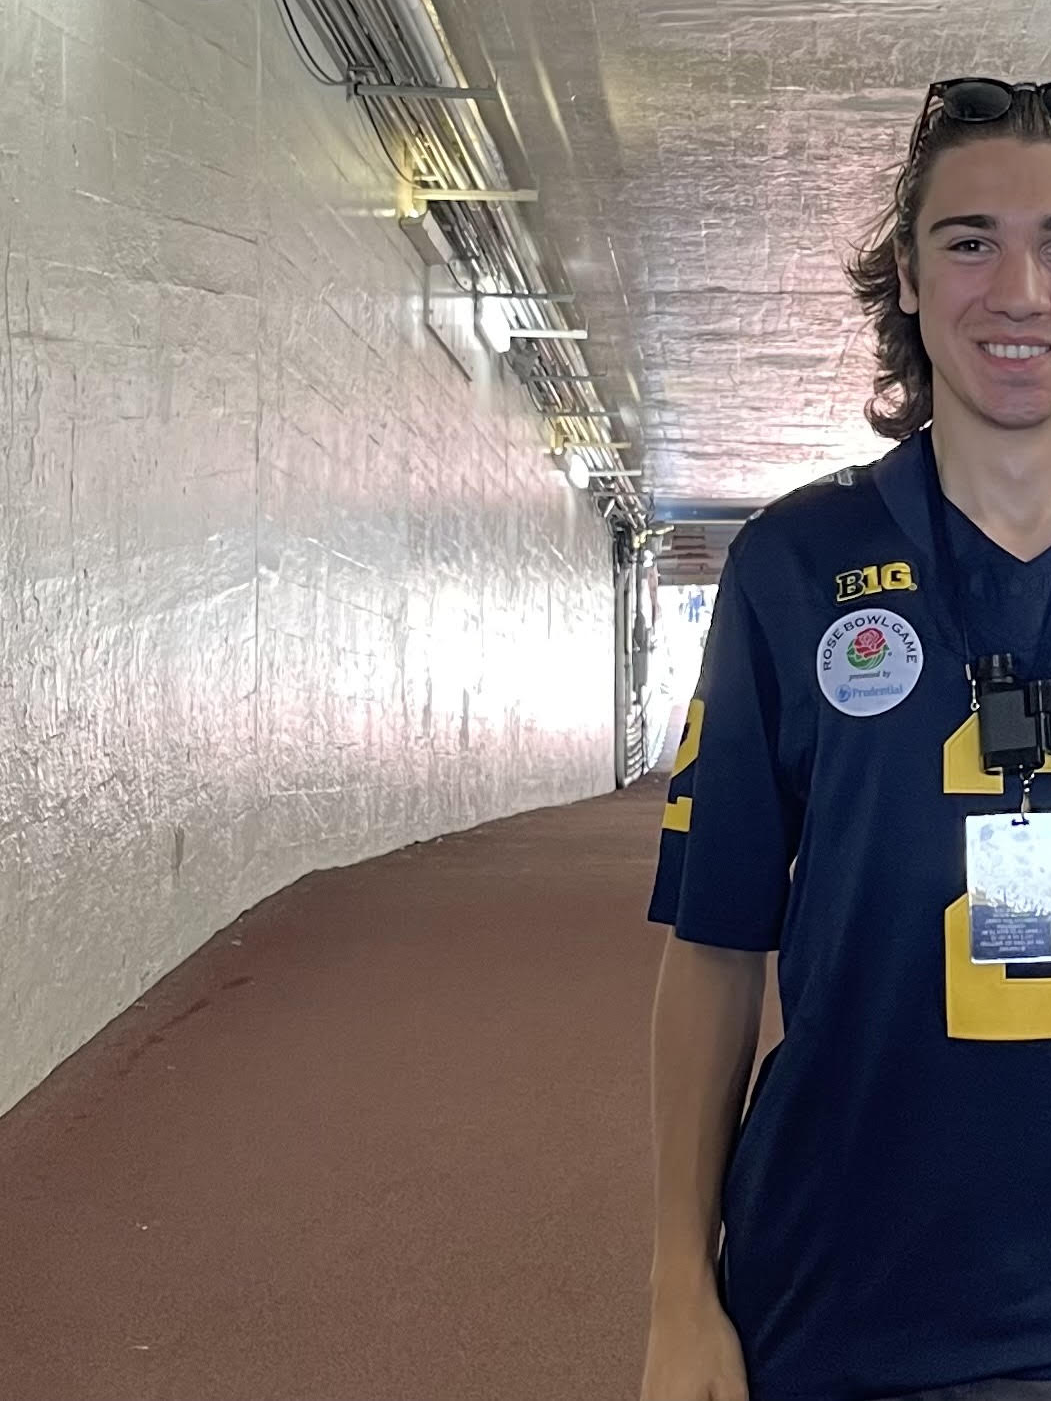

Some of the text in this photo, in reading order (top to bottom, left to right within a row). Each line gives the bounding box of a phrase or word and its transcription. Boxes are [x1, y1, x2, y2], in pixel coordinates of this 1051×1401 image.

[823, 615, 918, 671] ROSE BOWL GAME
[882, 670, 891, 679] by
[852, 684, 903, 699] Prudential
